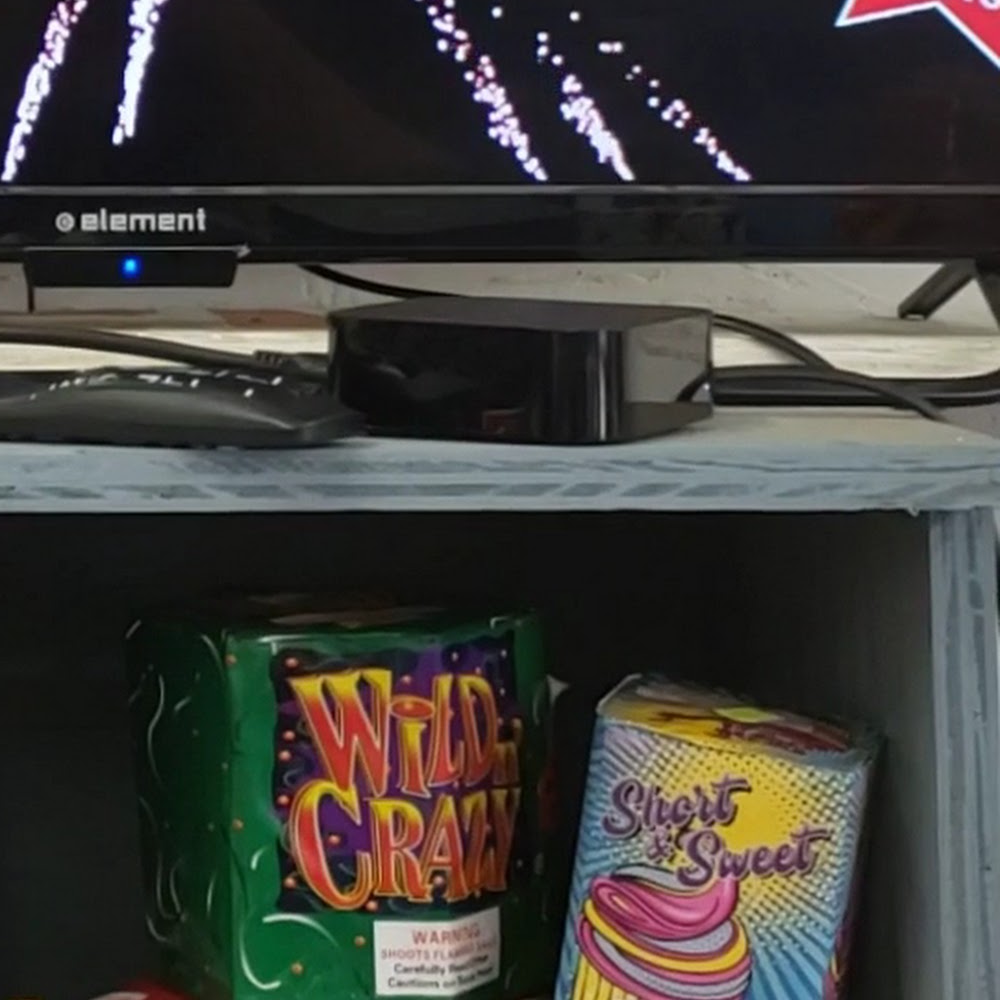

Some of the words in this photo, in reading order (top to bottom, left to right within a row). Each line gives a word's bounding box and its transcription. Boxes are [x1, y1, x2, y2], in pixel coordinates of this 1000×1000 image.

[80, 207, 206, 232] element
[602, 773, 752, 839] Short
[676, 825, 833, 888] Sweet
